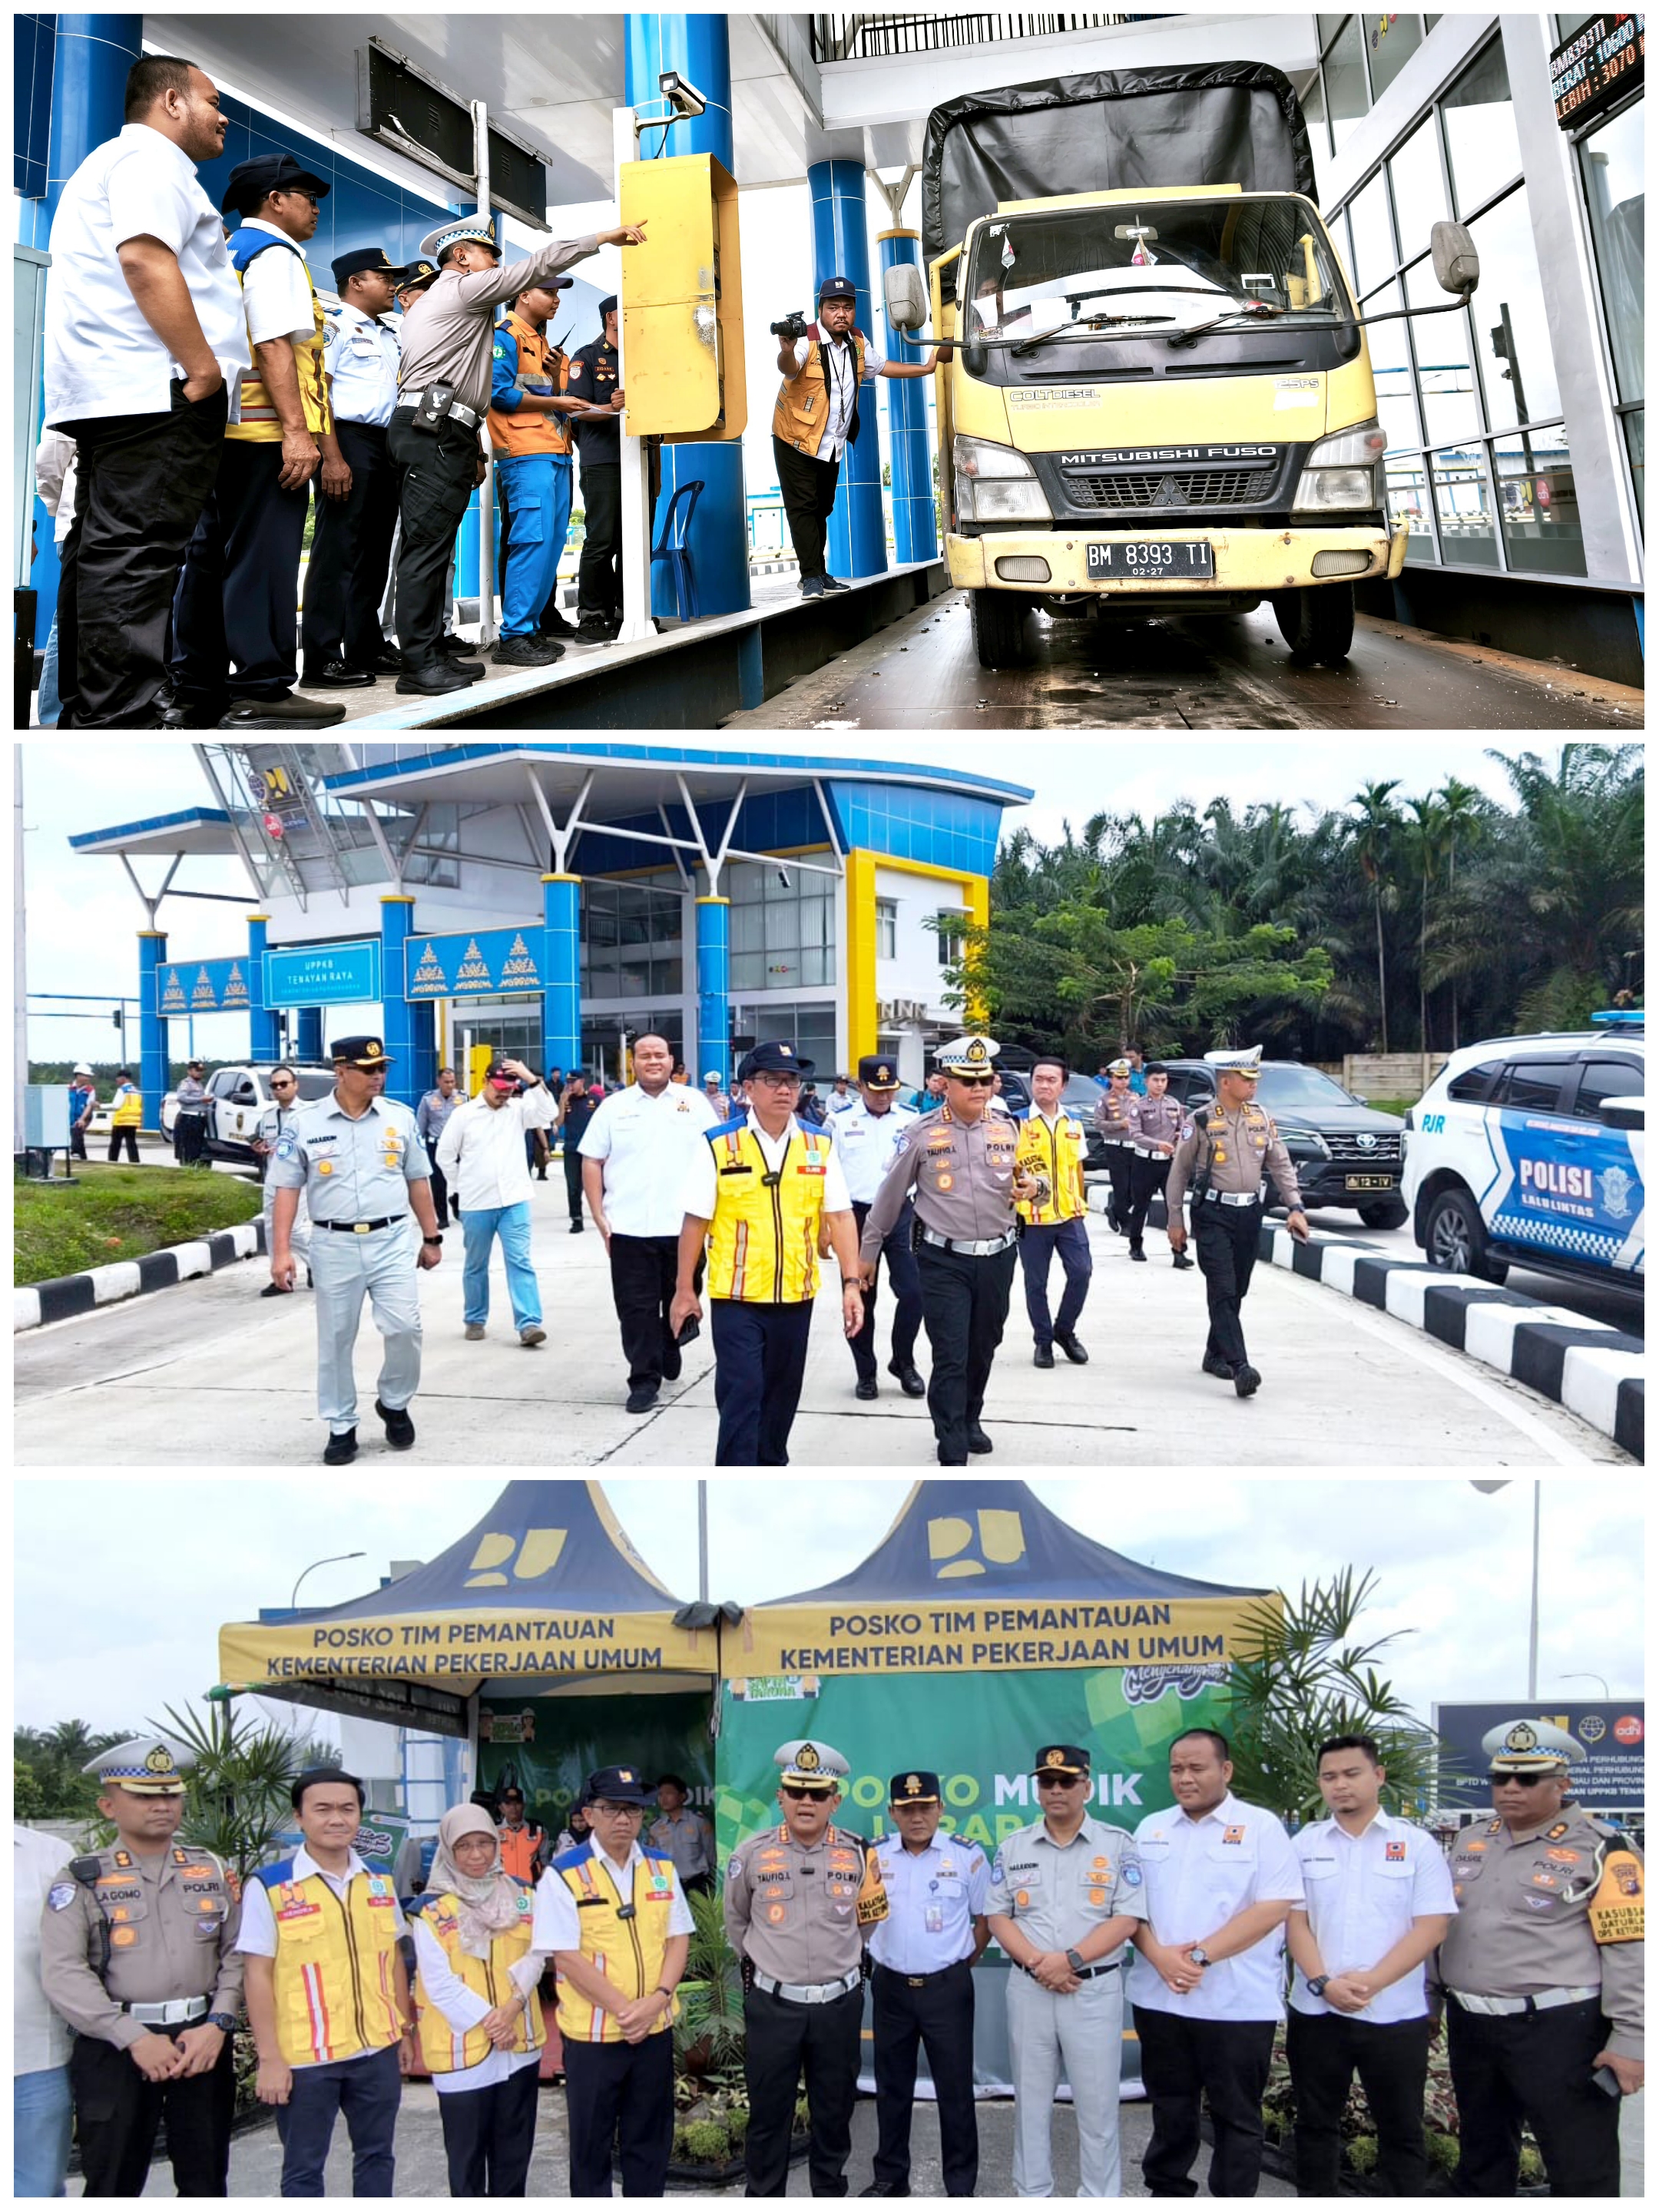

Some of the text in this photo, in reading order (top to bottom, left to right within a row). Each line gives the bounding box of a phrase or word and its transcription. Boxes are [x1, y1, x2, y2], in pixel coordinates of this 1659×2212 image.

[1551, 56, 1588, 101] BERAT
[1555, 78, 1591, 120] LEBIH
[1601, 43, 1636, 84] 3070
[1061, 446, 1277, 464] MITSUBISHI FUSO
[1088, 543, 1207, 567] BM 8393 TI
[287, 971, 353, 985] TENAYAN RAYA
[1422, 1114, 1445, 1134] PJR
[1520, 1158, 1592, 1199] POLISI
[1522, 1194, 1594, 1218] LALU LINTAS
[313, 1619, 614, 1647] POSKO TIM PEMANTAUAN
[830, 1604, 1171, 1637] POSKO TIM PEMANTAUAN
[267, 1647, 661, 1676] KEMENTERIAN PEKERJAAN UMUM
[781, 1634, 1224, 1669] KEMENTERIAN PEKERJAAN UMUM
[1533, 1861, 1575, 1875] POLRI
[183, 1882, 220, 1893] POLRI
